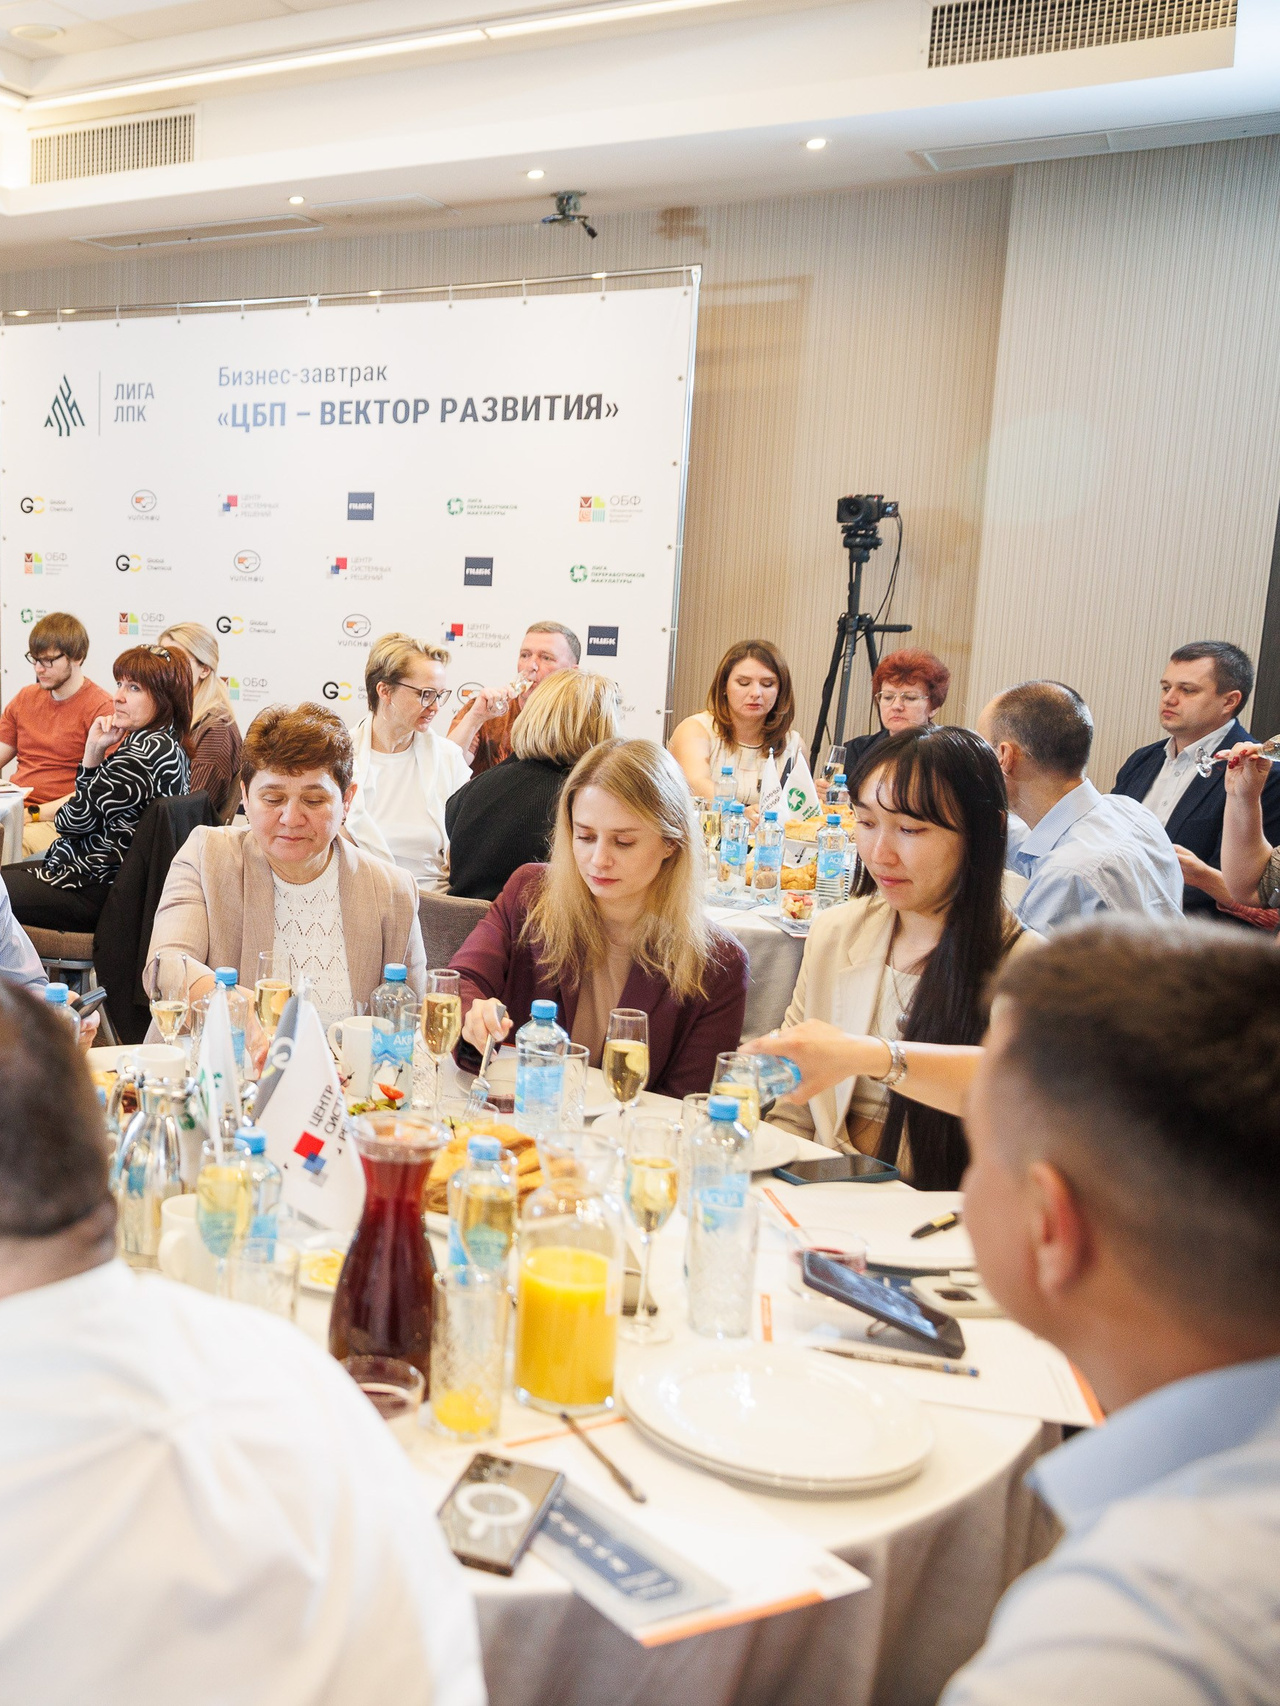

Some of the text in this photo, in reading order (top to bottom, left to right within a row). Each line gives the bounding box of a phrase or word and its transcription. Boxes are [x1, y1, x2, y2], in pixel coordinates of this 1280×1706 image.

[218, 364, 388, 388] Бизнес-завтрак
[113, 382, 156, 401] ЛИГА
[113, 404, 148, 423] ЛПК
[217, 402, 287, 433] «ЦБП
[320, 398, 430, 426] ВЕКТОР
[439, 393, 620, 423] РАЗВИТИЯ»
[609, 495, 642, 506] ОБФ
[141, 612, 165, 622] ОБФ
[243, 676, 269, 687] ОБФ
[308, 1084, 335, 1128] ЦЕНТР
